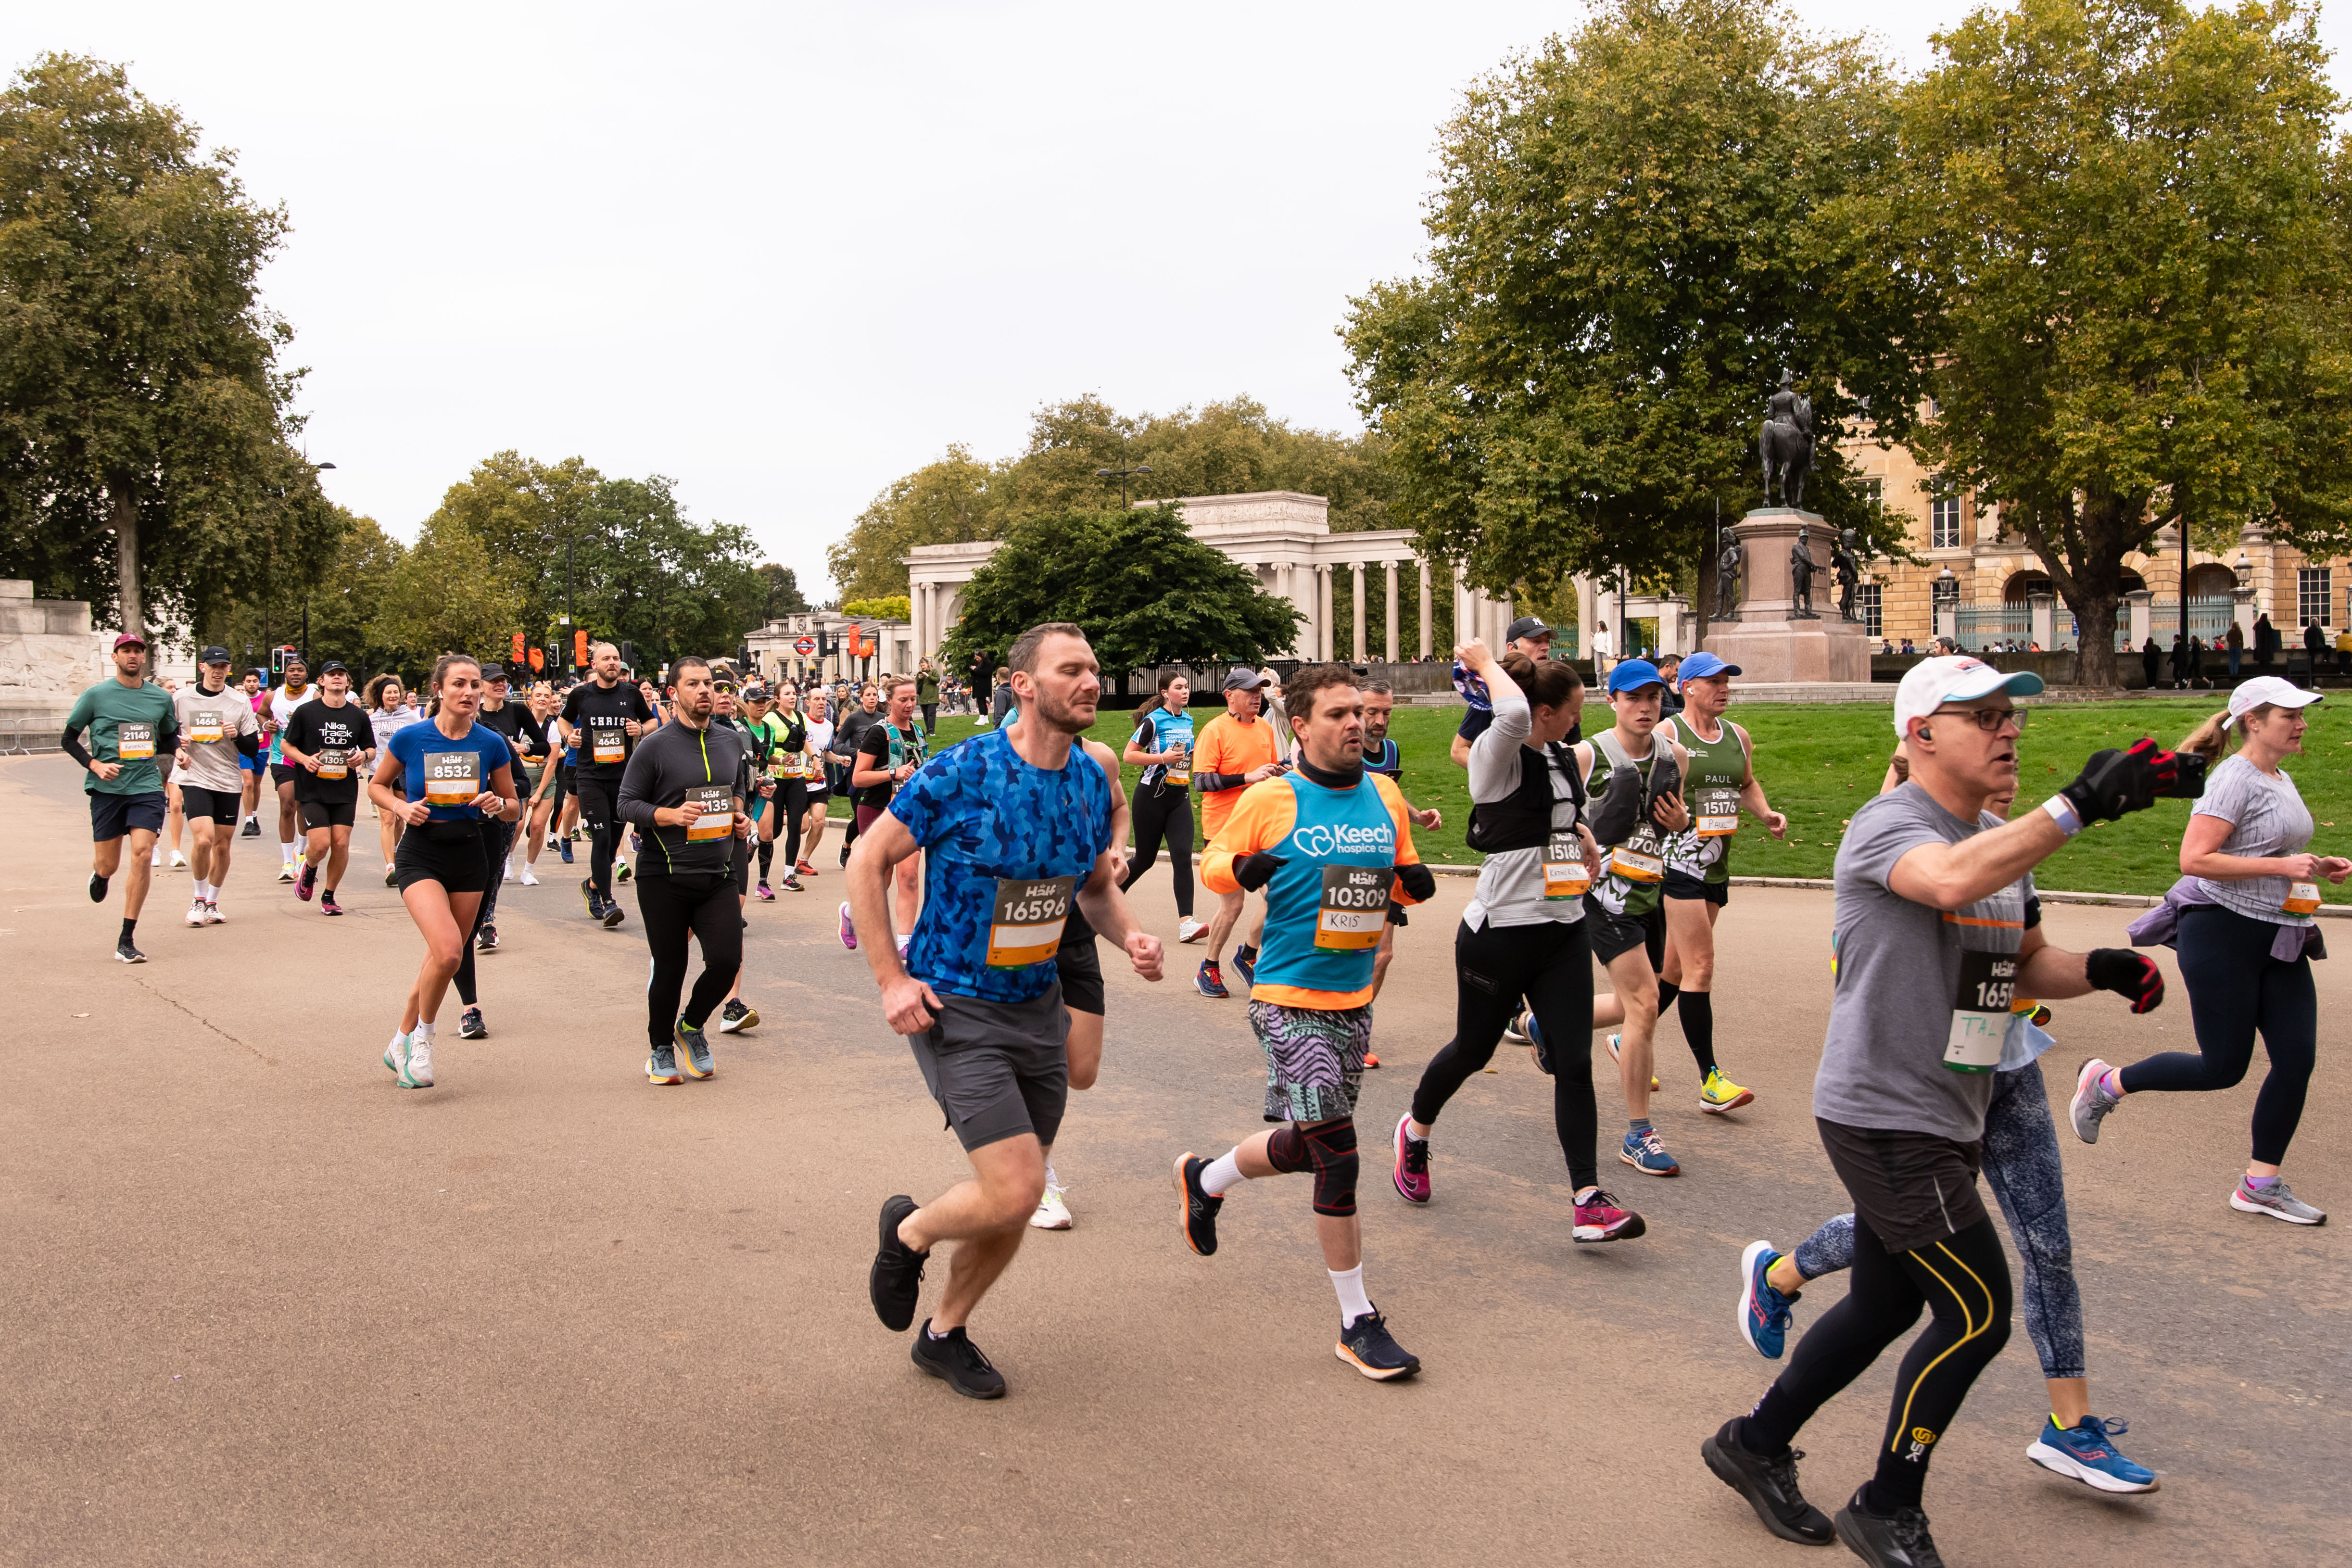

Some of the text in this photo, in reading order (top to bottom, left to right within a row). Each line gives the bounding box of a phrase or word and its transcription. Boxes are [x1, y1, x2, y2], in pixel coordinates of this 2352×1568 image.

[195, 718, 217, 726] 1468
[590, 717, 625, 726] CHRIS
[124, 731, 150, 740] 21149
[318, 729, 353, 737] Track
[598, 737, 620, 746] 4643
[442, 755, 462, 764] Half
[434, 765, 471, 778] 8532
[1705, 775, 1732, 783] PAUL
[701, 789, 720, 798] Half
[1712, 790, 1729, 799] Half
[1704, 801, 1736, 814] 15176
[1334, 823, 1392, 844] Keech
[1337, 843, 1394, 854] hospice care
[1548, 844, 1581, 860] 15186
[1349, 871, 1378, 885] Half
[1025, 884, 1056, 897] Half
[1328, 886, 1387, 907] 10309
[1004, 897, 1066, 921] 16596
[1330, 913, 1360, 928] KRIS
